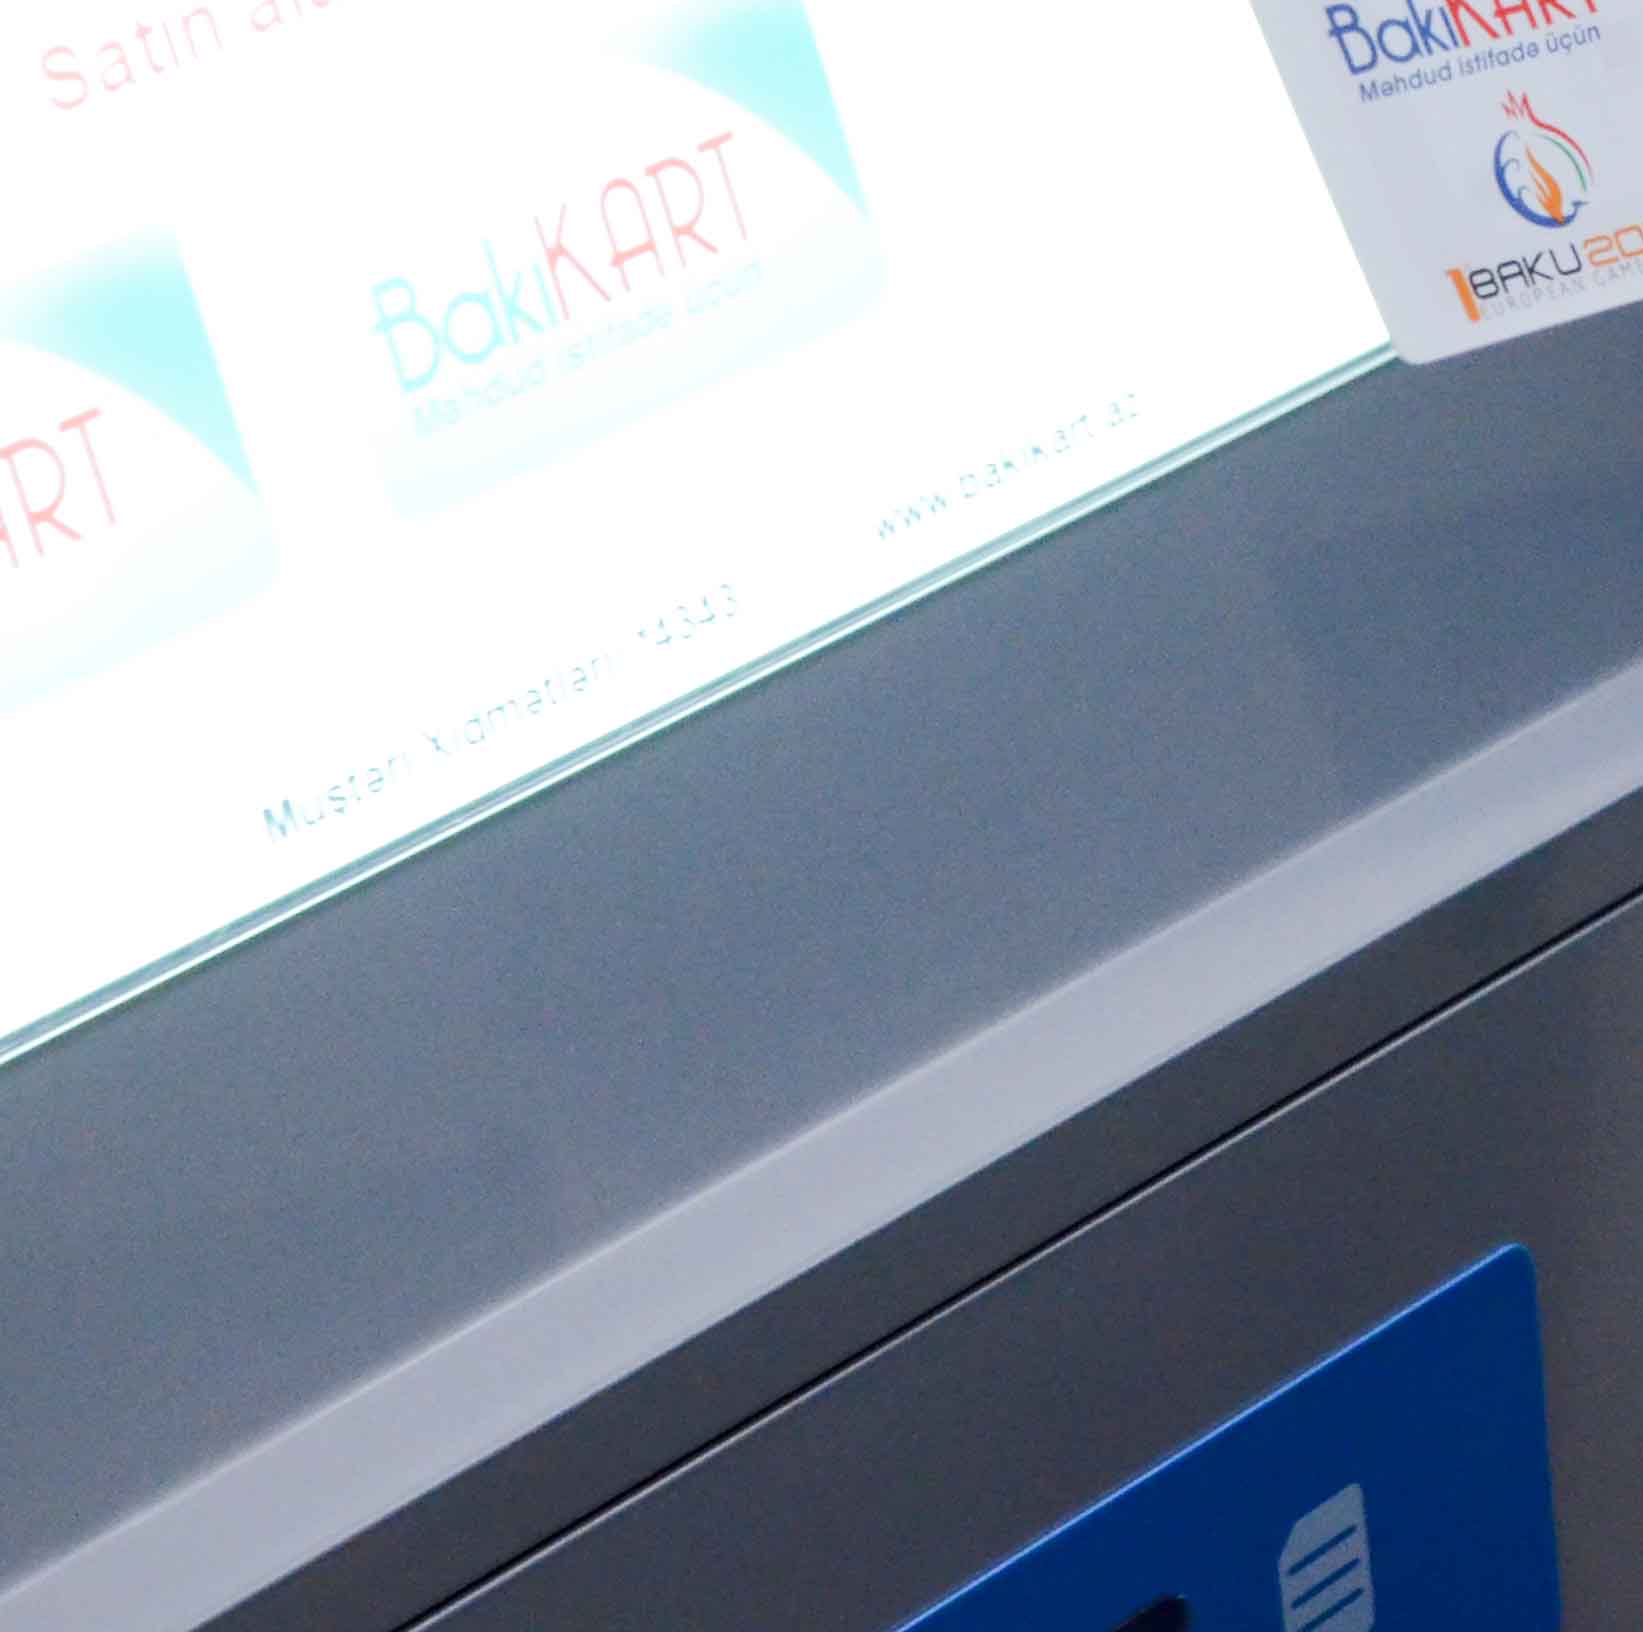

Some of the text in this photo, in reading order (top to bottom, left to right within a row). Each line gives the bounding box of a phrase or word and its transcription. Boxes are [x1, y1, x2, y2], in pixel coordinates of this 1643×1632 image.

[40, 2, 225, 110] Satın
[1358, 64, 1453, 102] Məhdud
[1545, 23, 1601, 55] üçün
